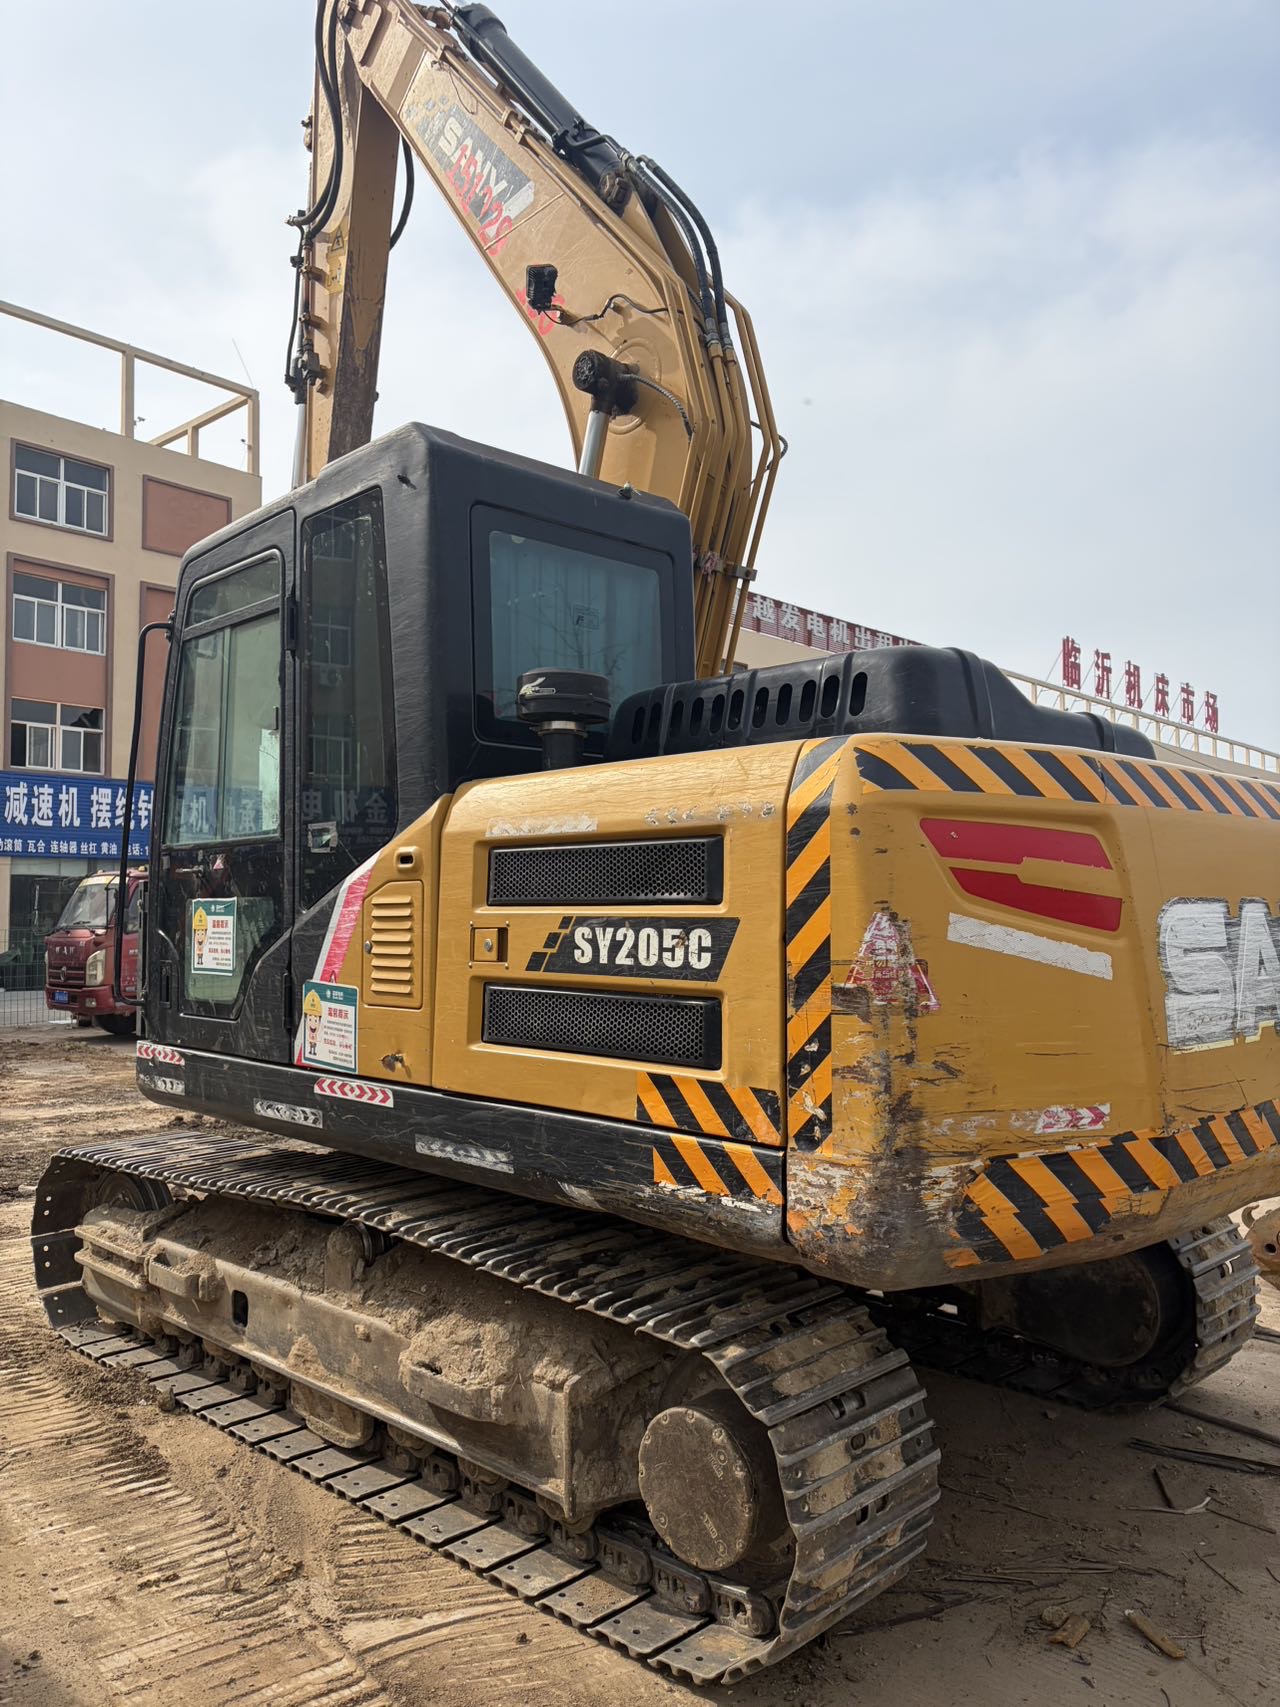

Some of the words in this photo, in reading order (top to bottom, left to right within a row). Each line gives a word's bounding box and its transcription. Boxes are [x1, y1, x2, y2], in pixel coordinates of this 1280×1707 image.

[735, 590, 912, 650] 越发电机出租
[1062, 635, 1219, 733] 临沂机床市场
[4, 782, 80, 827] 减速机
[27, 840, 46, 853] 瓦合
[101, 842, 118, 855] 黄油
[573, 926, 712, 969] SY205C
